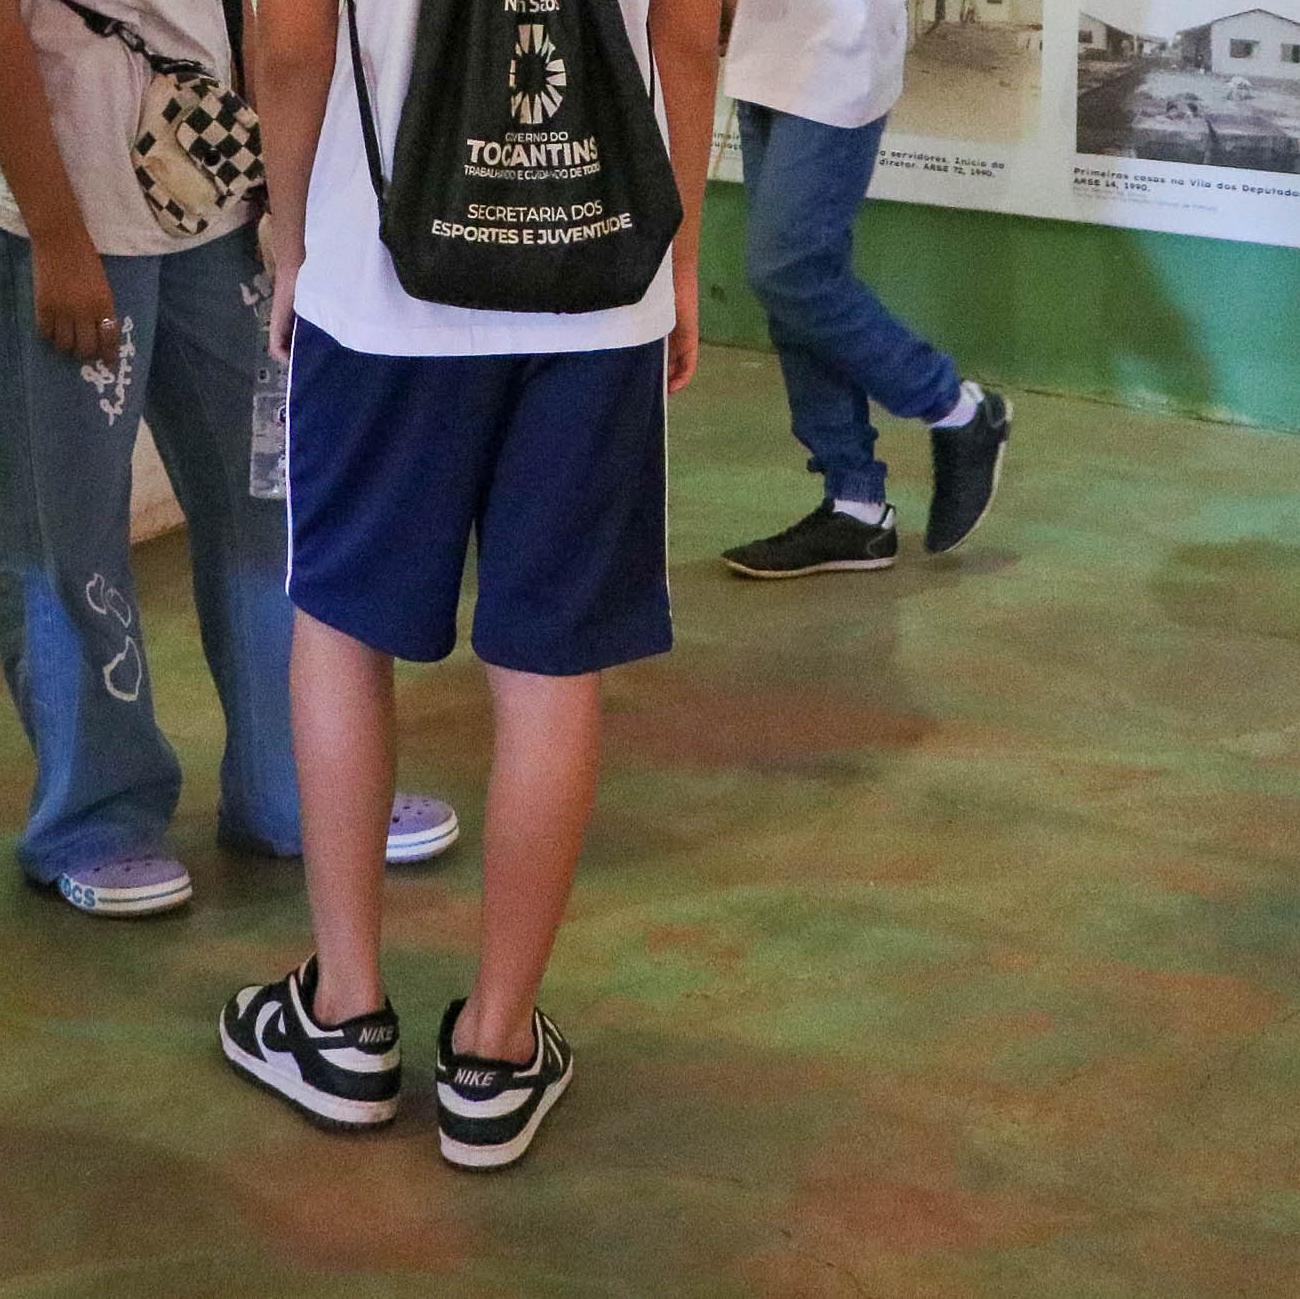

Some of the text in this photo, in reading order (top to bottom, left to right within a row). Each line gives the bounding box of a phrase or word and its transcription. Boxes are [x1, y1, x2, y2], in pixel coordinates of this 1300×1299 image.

[550, 131, 569, 141] DO
[467, 136, 598, 167] TOCANTINS
[569, 167, 583, 179] DE
[1073, 167, 1129, 180] Primeiras
[1134, 173, 1166, 183] casas
[1170, 177, 1185, 185] na
[1190, 178, 1211, 189] Vila
[1217, 181, 1237, 191] dos
[1073, 177, 1100, 187] ARSE
[467, 200, 603, 223] SECRETARIA DOS
[431, 213, 633, 244] ESPORTES E JUVENTUDE
[358, 1025, 394, 1044] NIKE
[453, 1067, 497, 1088] NIKE
